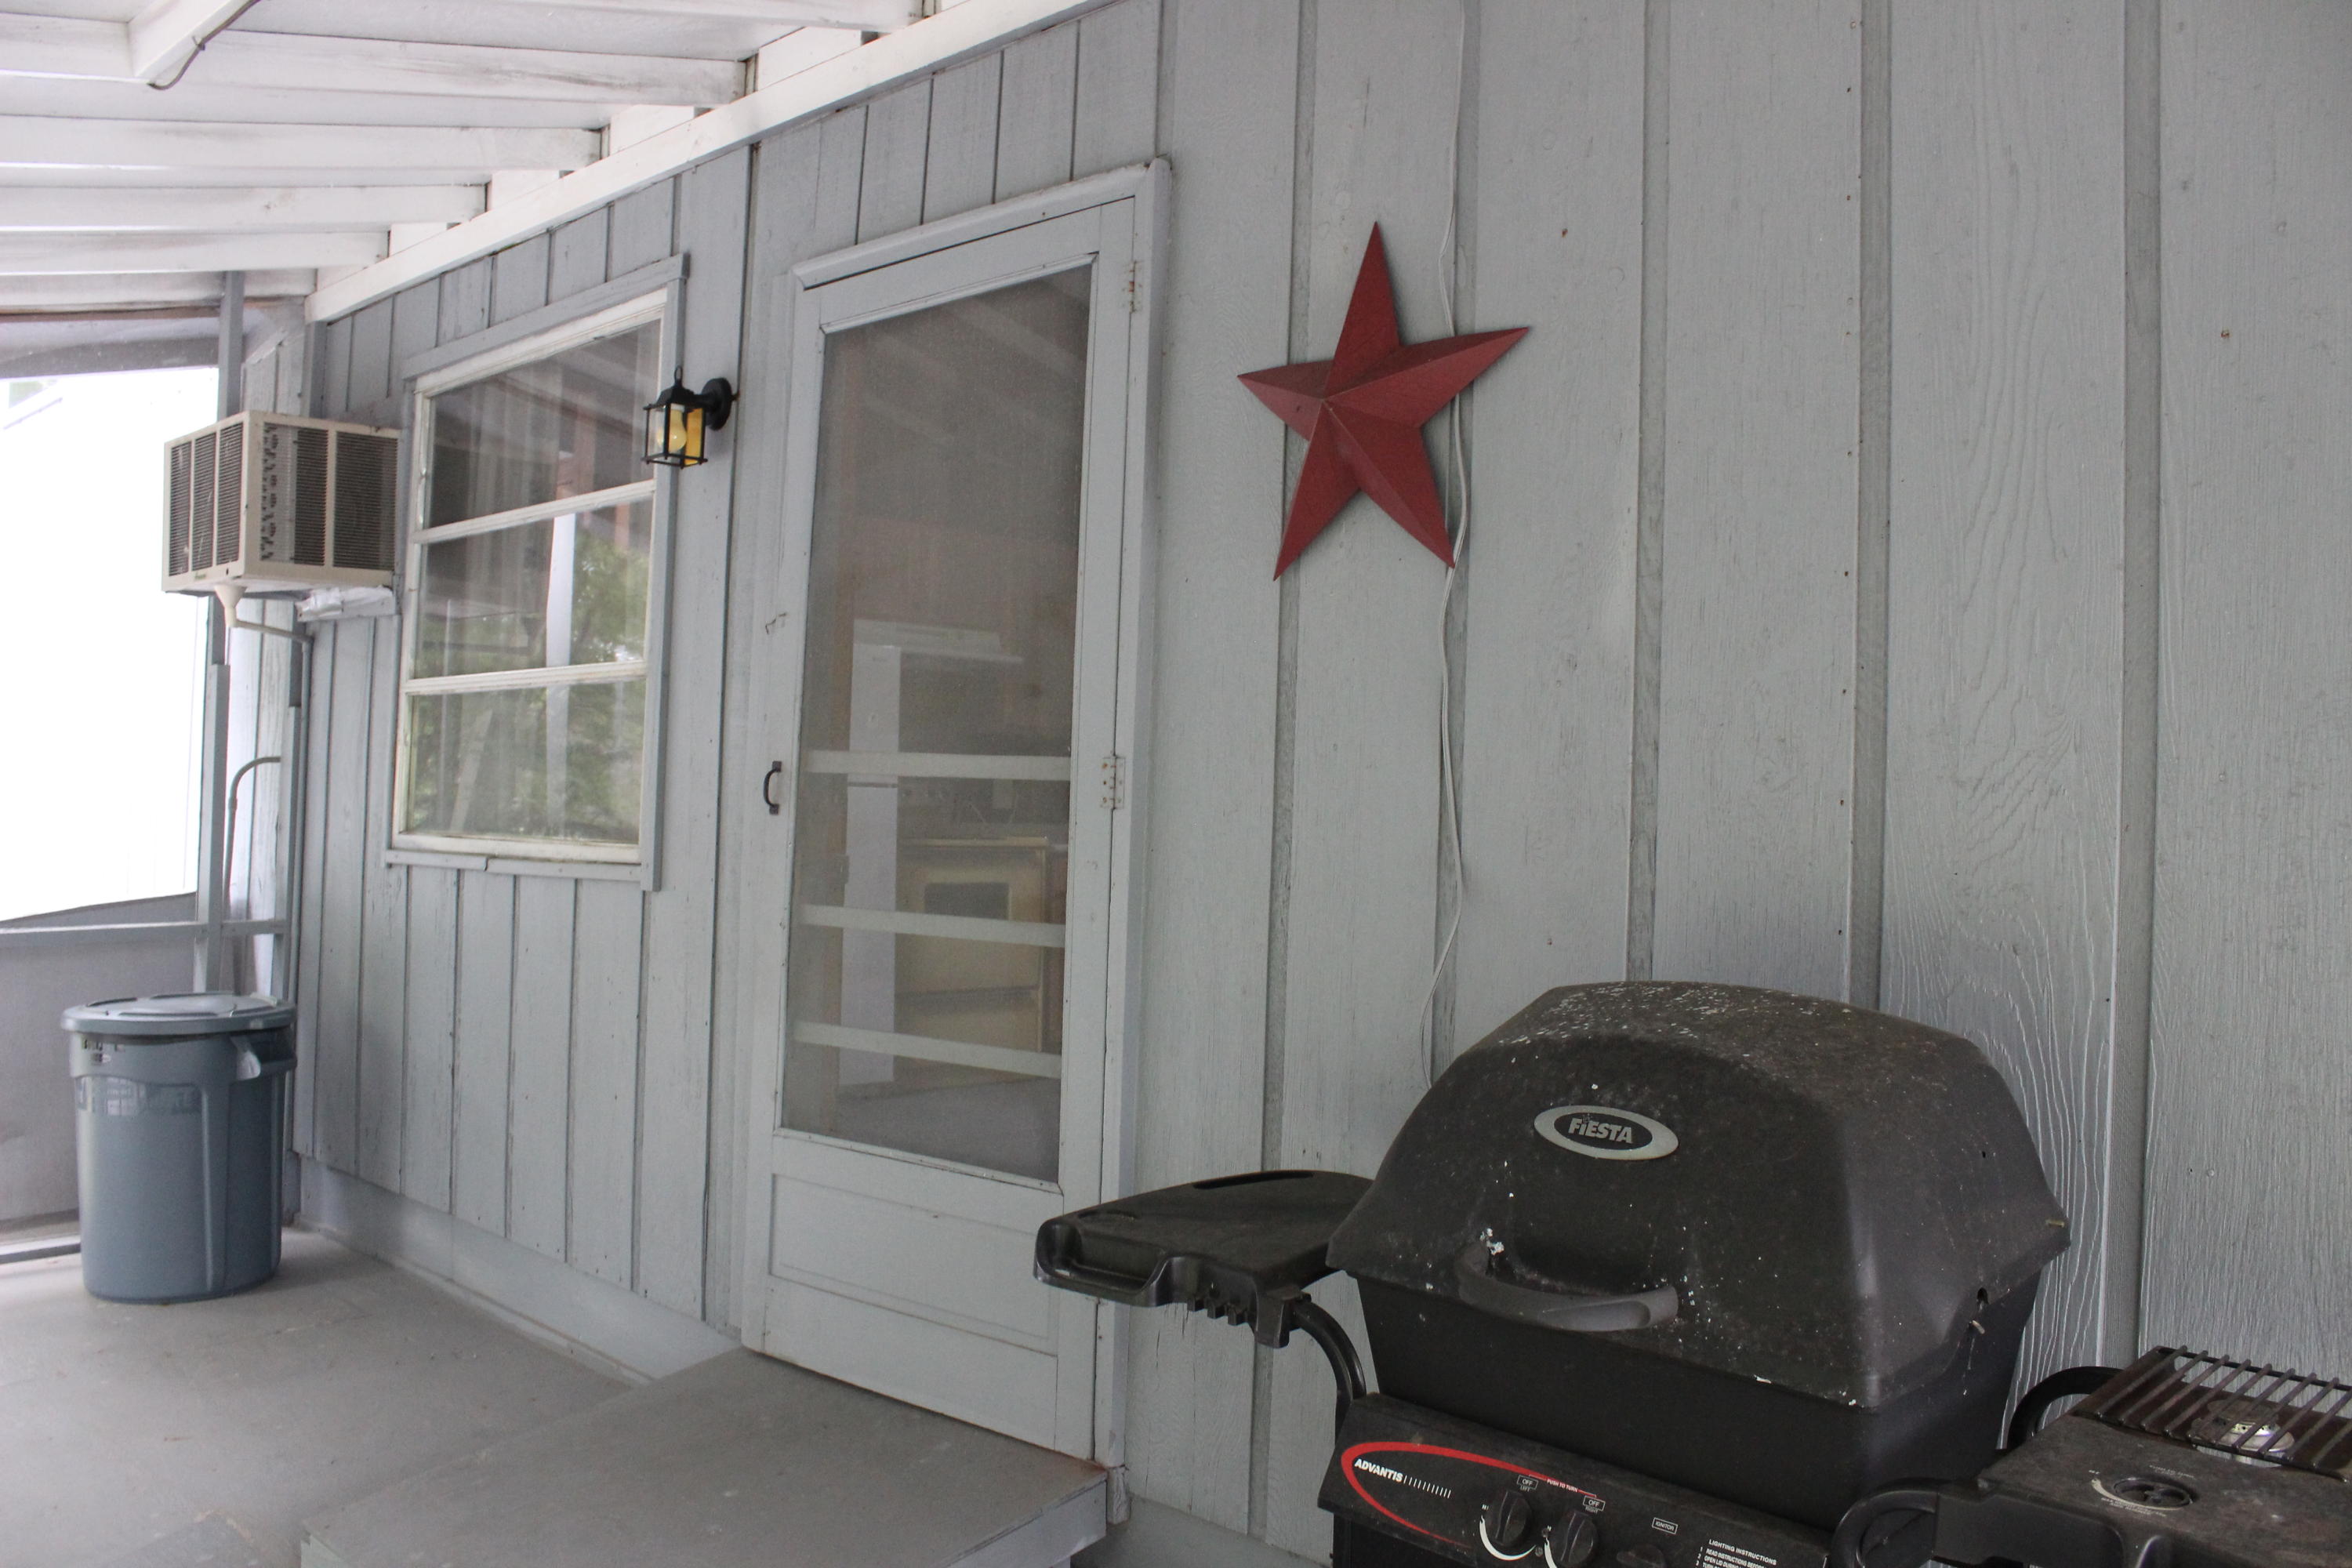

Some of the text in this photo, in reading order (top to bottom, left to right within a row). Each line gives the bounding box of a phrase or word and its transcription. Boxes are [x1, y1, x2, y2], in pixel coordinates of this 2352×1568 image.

[1355, 1458, 1403, 1483] ADVANTIS
[1709, 1539, 1777, 1566] LIGHTING INSTRUCTIONS
